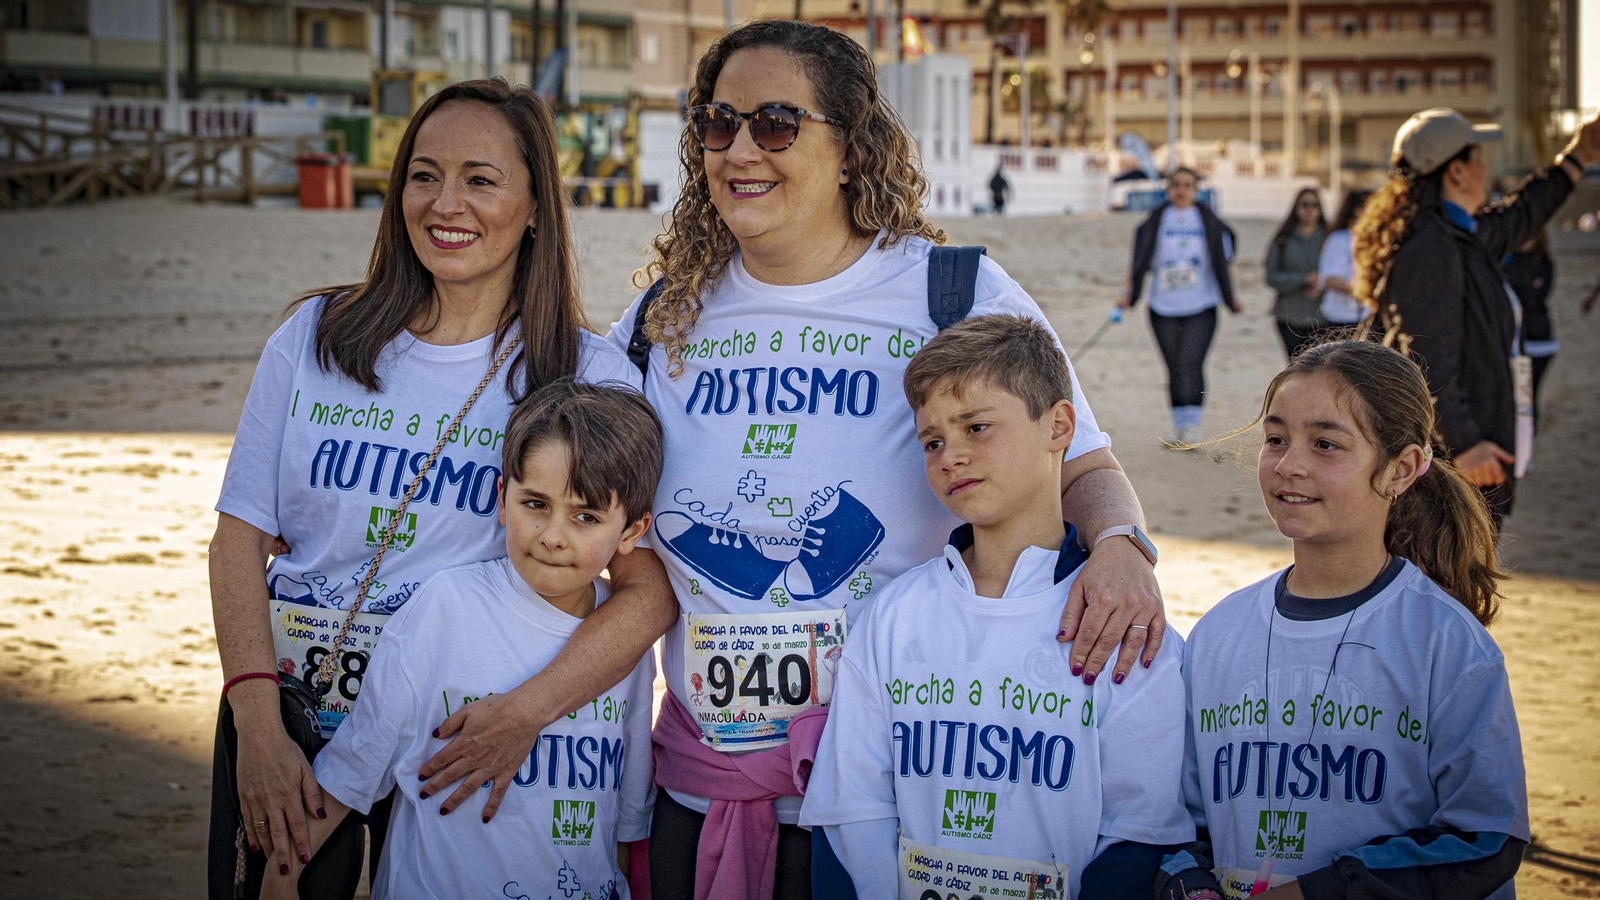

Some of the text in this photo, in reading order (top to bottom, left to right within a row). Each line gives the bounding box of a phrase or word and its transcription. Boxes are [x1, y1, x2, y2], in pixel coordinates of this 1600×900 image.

[769, 329, 783, 352] a
[799, 325, 872, 356] favor
[686, 366, 880, 419] AUTISMO
[309, 401, 394, 432] marcha
[406, 413, 421, 437] a
[310, 438, 503, 518] AUTISMO
[673, 480, 853, 556] Cada paso cuenta
[294, 614, 329, 629] MARCHA
[332, 620, 340, 630] A
[346, 622, 371, 635] AVOR
[319, 632, 330, 643] de
[698, 625, 726, 636] MARCHA
[729, 625, 736, 636] A
[739, 625, 768, 636] FAVOR
[772, 624, 789, 635] DEL
[718, 640, 728, 651] de
[761, 642, 770, 650] 30
[772, 641, 782, 650] de
[707, 653, 811, 708] 940
[968, 679, 983, 706] a
[998, 676, 1072, 718] favor
[697, 712, 767, 723] INMACULADA
[1200, 693, 1267, 733] marcha
[1281, 699, 1296, 726] a
[1310, 693, 1383, 731] favor
[892, 719, 1076, 792] AUTISMO
[1213, 741, 1388, 805] AUTISMO
[553, 839, 577, 847] AUTISMO
[941, 829, 993, 841] AUTISMO CÁDIZ
[914, 855, 943, 871] MARCHA
[946, 862, 954, 872] A
[957, 864, 988, 879] FAVOR
[992, 869, 1010, 881] DEL
[1285, 852, 1304, 860] CÁDIZ
[933, 875, 943, 886] de
[978, 885, 988, 894] 30
[990, 886, 1000, 896] de
